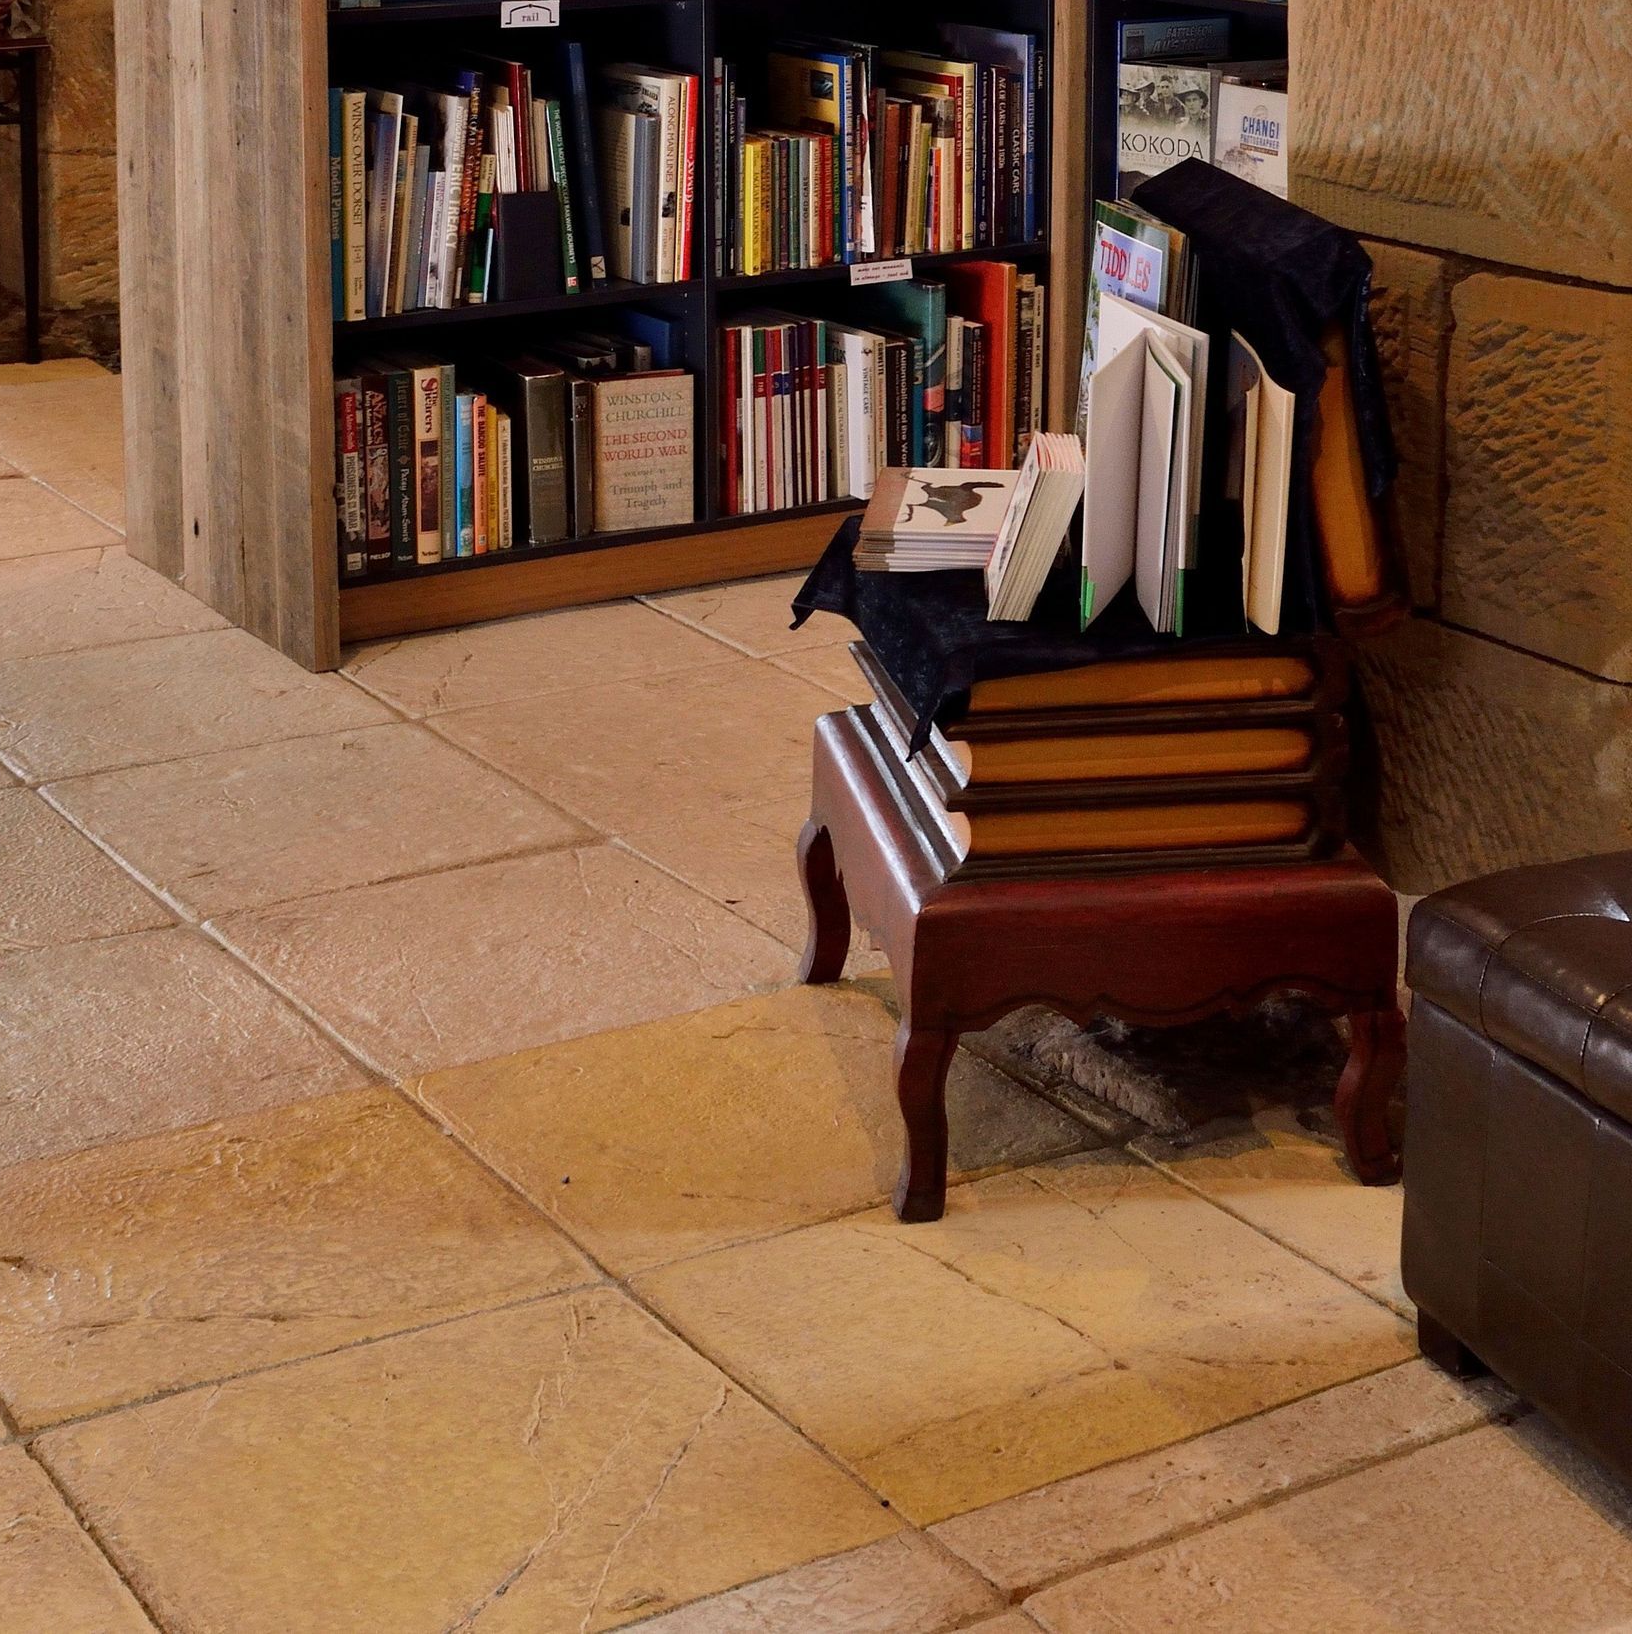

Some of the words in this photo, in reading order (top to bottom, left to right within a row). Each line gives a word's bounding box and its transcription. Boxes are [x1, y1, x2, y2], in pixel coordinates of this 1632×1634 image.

[522, 12, 540, 22] rail
[351, 101, 362, 141] WINGS
[1242, 116, 1280, 139] CHANGI
[1011, 129, 1020, 165] CLASSIC
[1122, 132, 1203, 159] KOKODA
[352, 146, 362, 177] OVER
[1012, 168, 1020, 193] CARS
[352, 181, 362, 226] DORSET
[606, 392, 663, 406] WINSTON
[606, 408, 686, 423] CHURCHILL
[604, 434, 627, 446] THE
[630, 429, 687, 444] SECOND
[604, 447, 652, 462] WORLD
[659, 445, 688, 457] WAR
[625, 496, 667, 510] Tragedy
